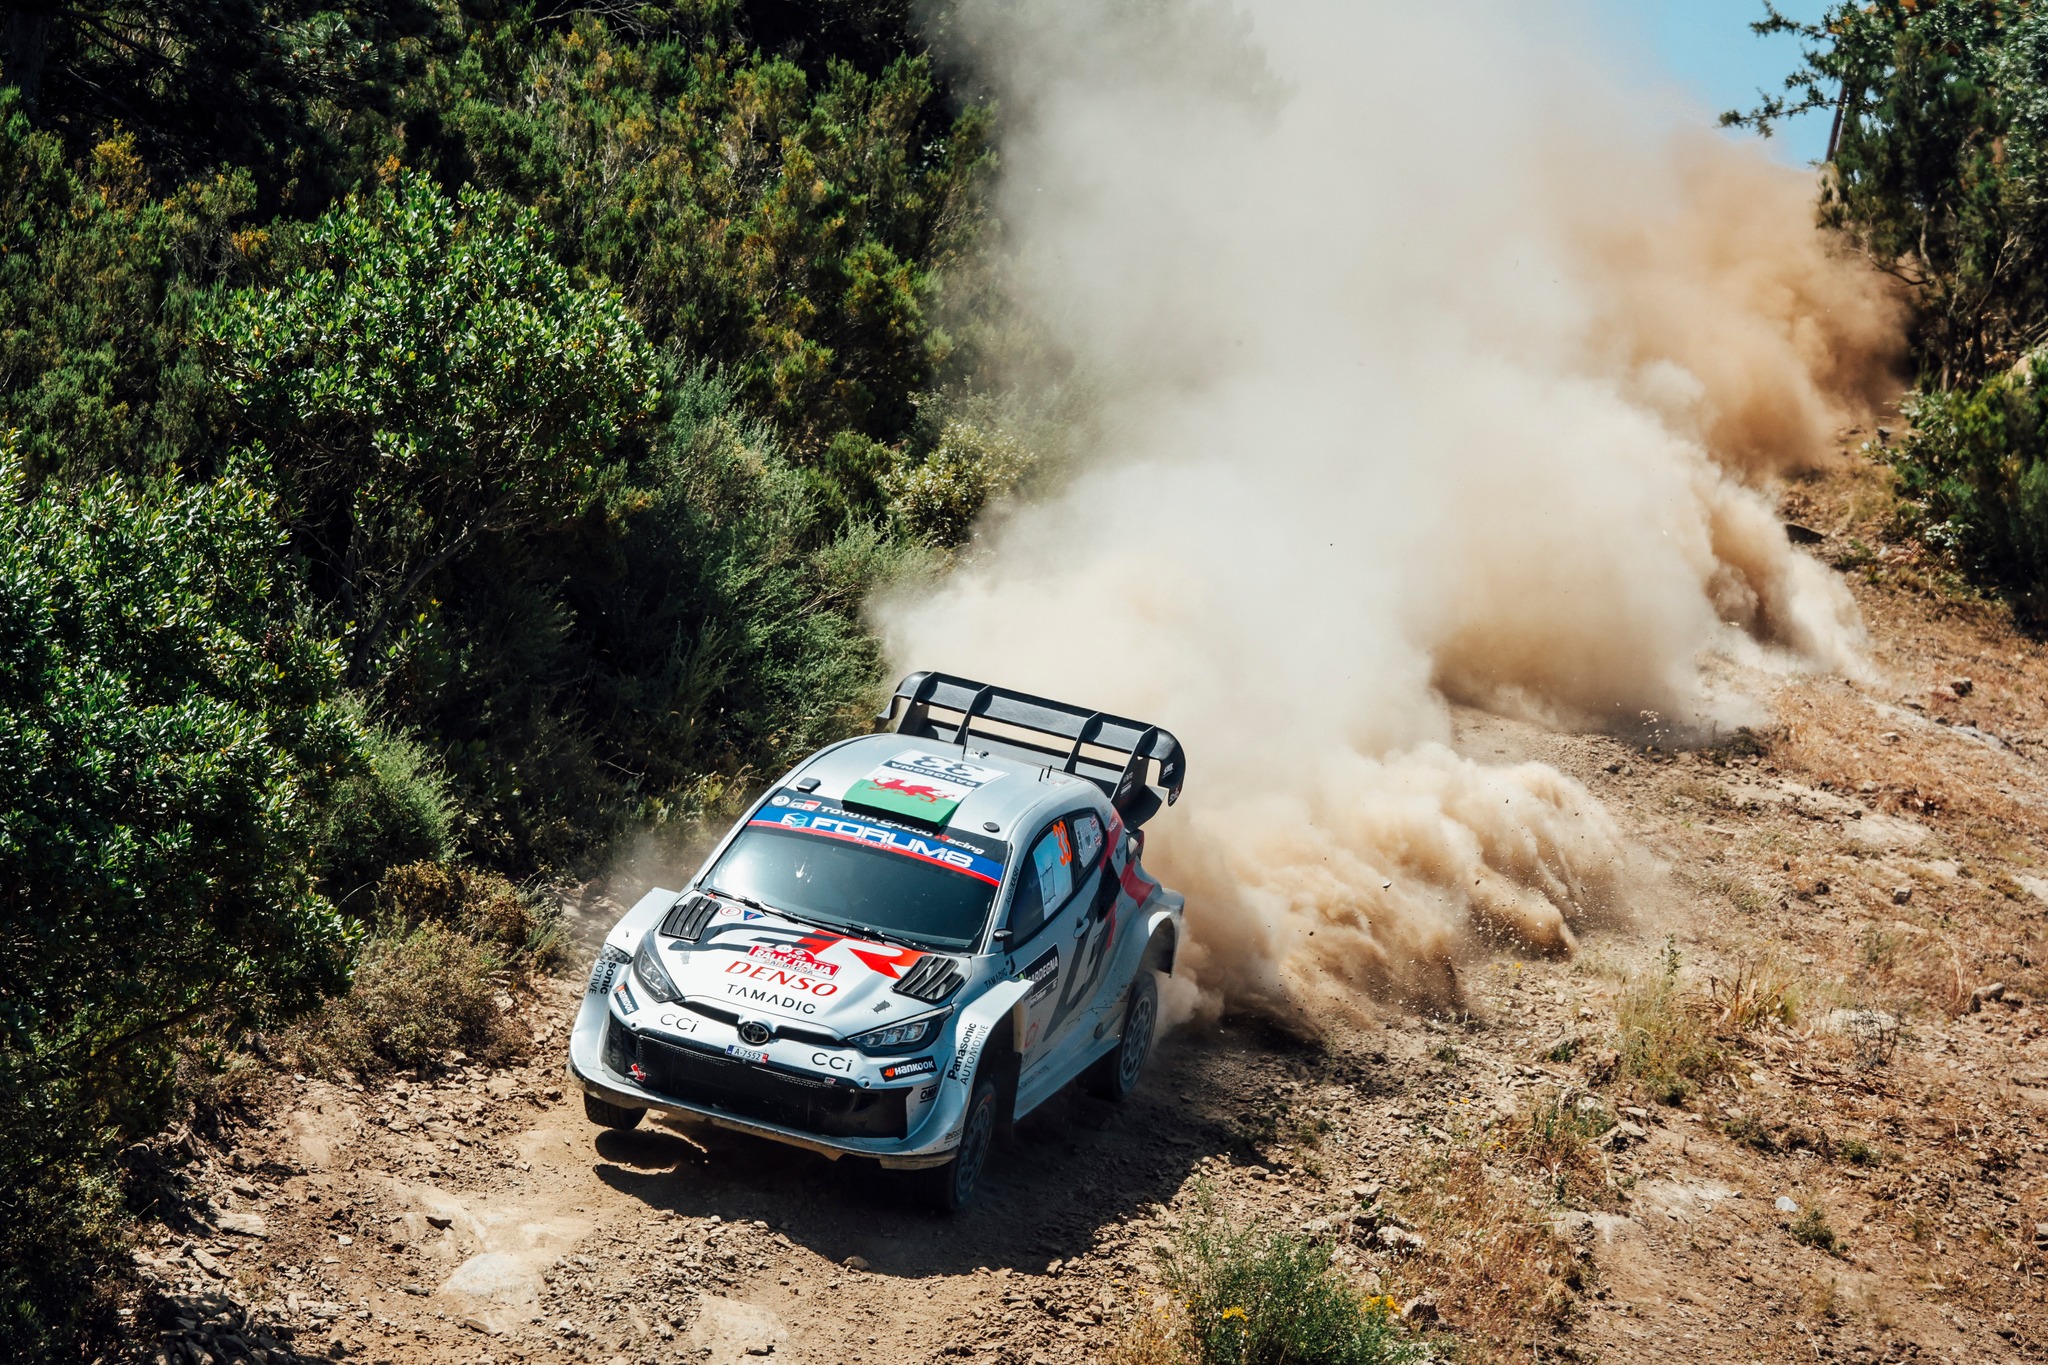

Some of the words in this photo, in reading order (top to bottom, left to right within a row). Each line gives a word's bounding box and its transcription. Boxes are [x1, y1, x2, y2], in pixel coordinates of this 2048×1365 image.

[890, 762, 977, 788] SARDEGNA
[913, 756, 985, 777] 33
[810, 816, 974, 868] FORUM8
[821, 806, 877, 823] TOYOTA
[876, 819, 934, 837] GAZOO
[934, 834, 985, 855] Racing
[1053, 820, 1073, 867] 33
[600, 961, 617, 995] sonic
[724, 961, 838, 997] DENSO
[754, 949, 793, 964] RALLY
[792, 960, 832, 975] ITALIA
[727, 983, 816, 1015] TAMADIC
[734, 1048, 761, 1061] A-7552
[947, 1022, 977, 1080] Panasonic
[960, 1024, 989, 1086] AUTOMOTIVE
